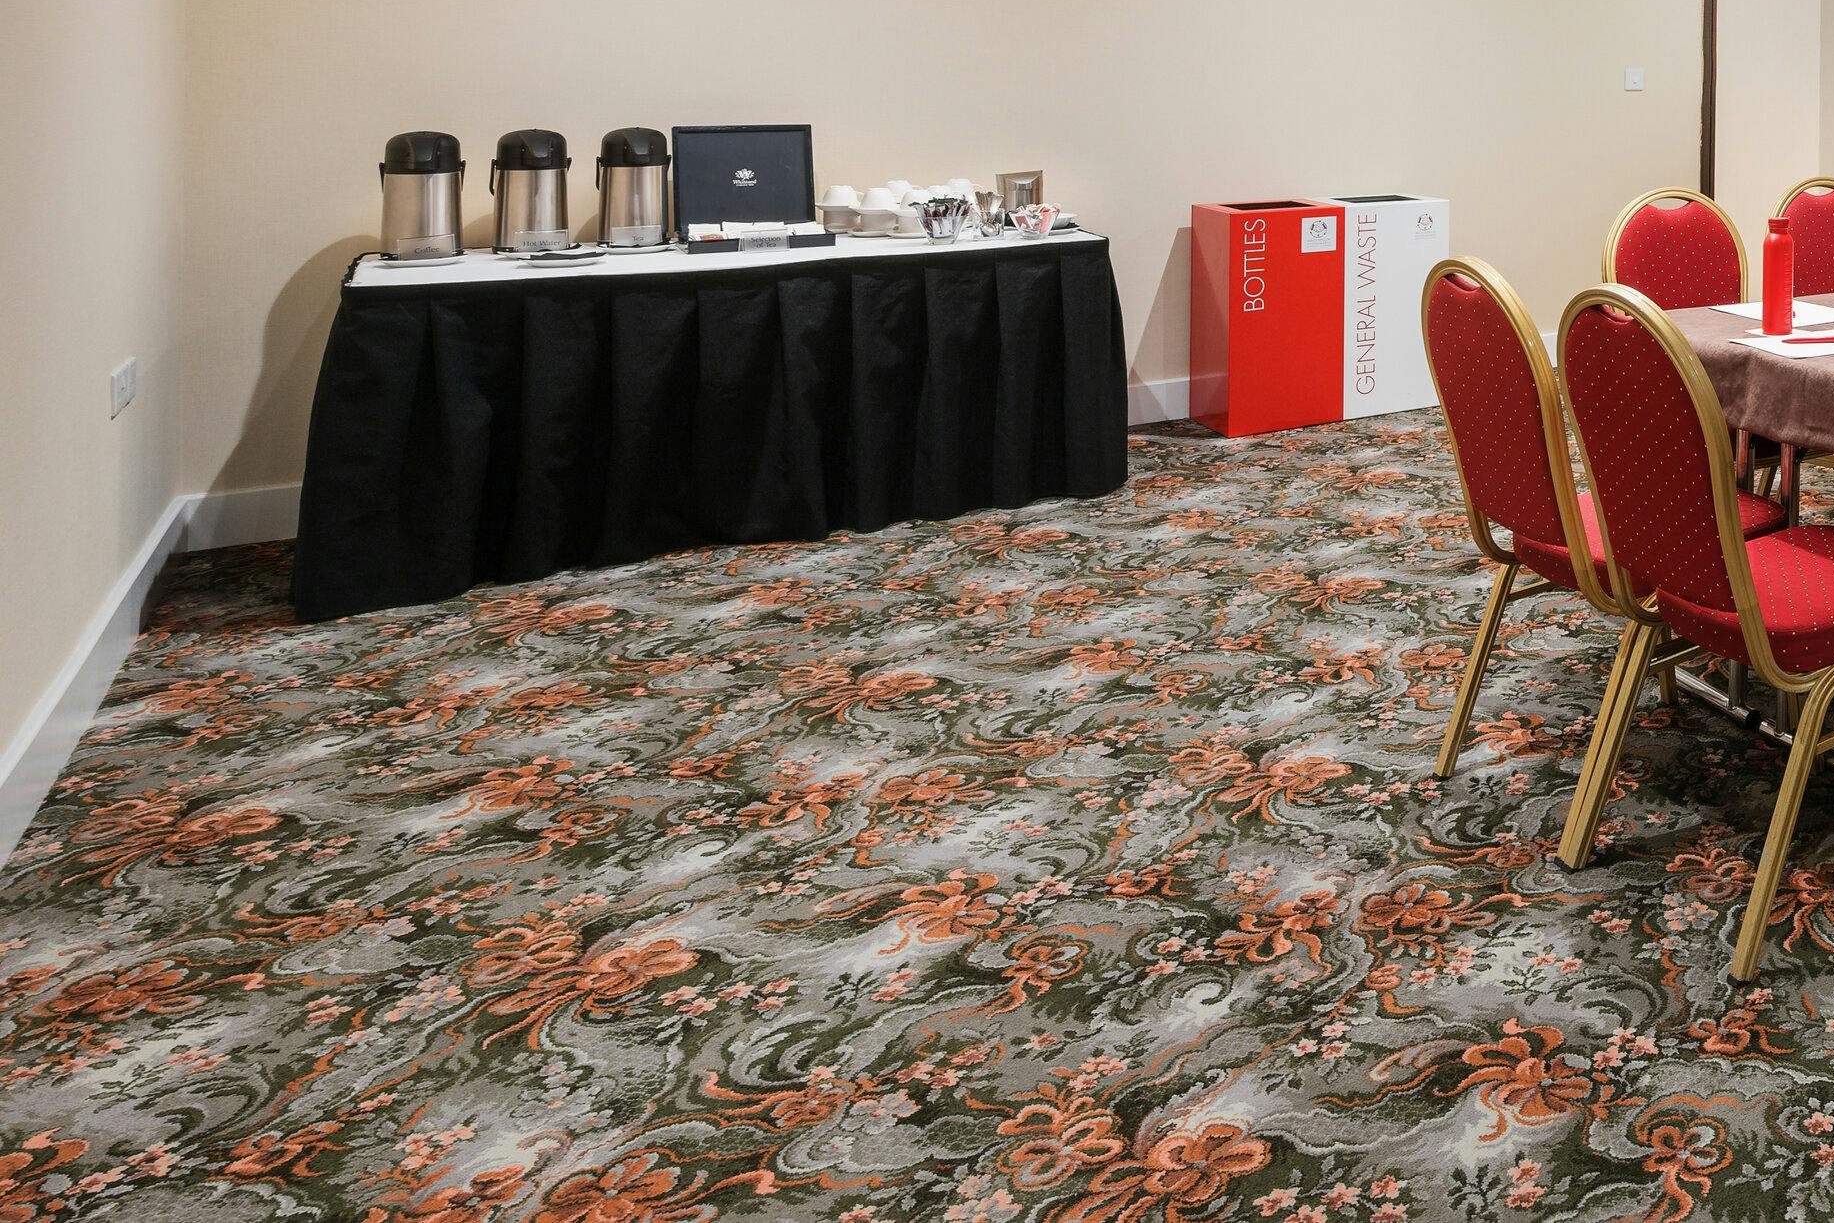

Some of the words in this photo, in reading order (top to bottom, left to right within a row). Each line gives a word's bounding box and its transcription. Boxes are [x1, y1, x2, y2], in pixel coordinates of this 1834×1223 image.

[1243, 218, 1266, 312] BOTTLES
[1356, 213, 1377, 289] WASTE
[1355, 295, 1376, 395] GENERAL
